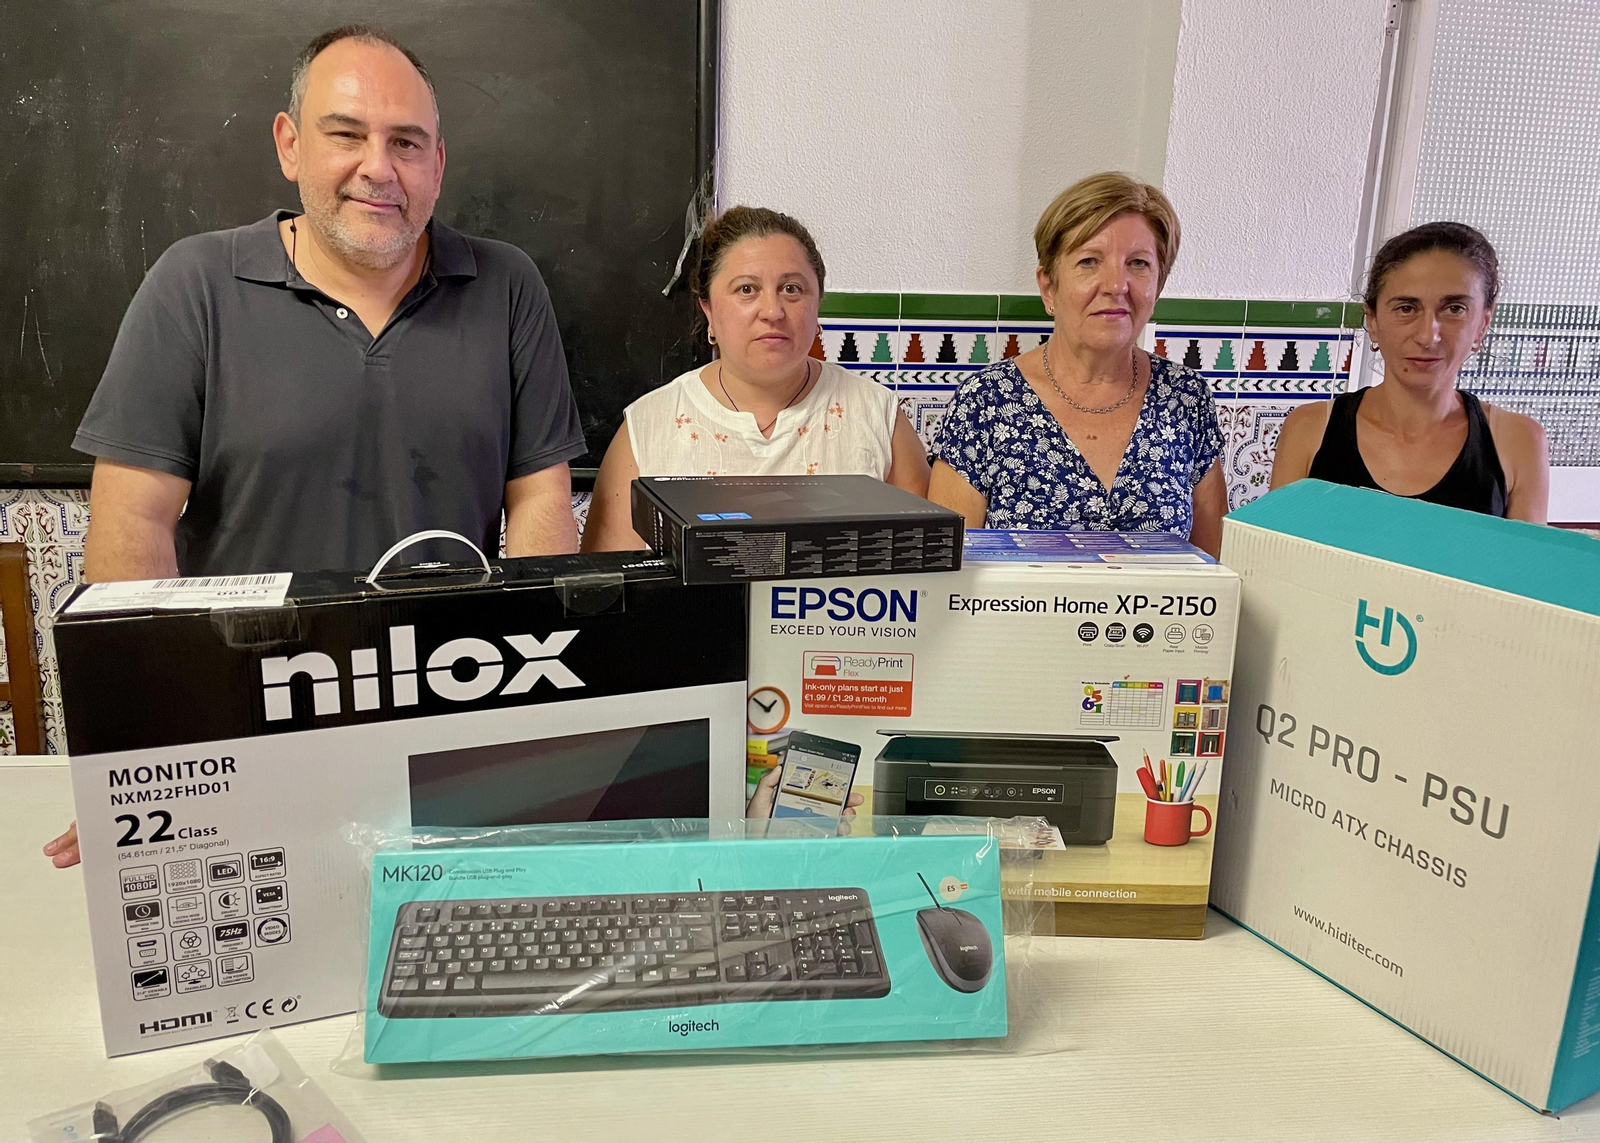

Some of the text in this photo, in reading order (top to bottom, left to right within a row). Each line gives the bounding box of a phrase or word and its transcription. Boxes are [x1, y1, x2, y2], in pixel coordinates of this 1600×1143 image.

[771, 586, 918, 623] EPSON
[949, 594, 1217, 616] Expression Home XP-2150
[770, 625, 917, 638] EXCEED YOUR VISION
[843, 655, 903, 669] ReadyPrint
[261, 625, 586, 721] nilox
[843, 669, 859, 677] Flex
[805, 683, 836, 692] Ink-only
[837, 684, 859, 693] plans
[888, 685, 904, 694] just
[804, 693, 826, 701] €1.99
[832, 694, 854, 702] £1.29
[862, 695, 887, 703] month
[109, 756, 237, 787] MONITOR
[1255, 703, 1510, 840] Q2 PRO - PSU
[110, 780, 230, 806] NXM22FHD01
[1032, 787, 1056, 795] EPSON
[114, 810, 218, 848] 22 Class
[1270, 778, 1468, 889] MICRO ATX CHASSIS
[118, 849, 158, 860] (54.61cm
[190, 839, 230, 851] Diagonal)
[259, 855, 276, 863] 16:9
[217, 867, 234, 875] LED
[382, 864, 443, 883] MK120
[125, 881, 156, 892] 1080P
[168, 878, 202, 887] 1920x1080
[946, 884, 956, 893] ES
[828, 894, 858, 902] logitech
[1008, 886, 1031, 896] with
[1034, 887, 1072, 897] mobile
[1074, 889, 1137, 899] connection
[219, 927, 243, 936] 75Hz
[1293, 904, 1404, 978] www.hiditec.com
[959, 945, 979, 953] logitech
[139, 1011, 213, 1034] HDMI
[669, 1019, 720, 1037] logitech
